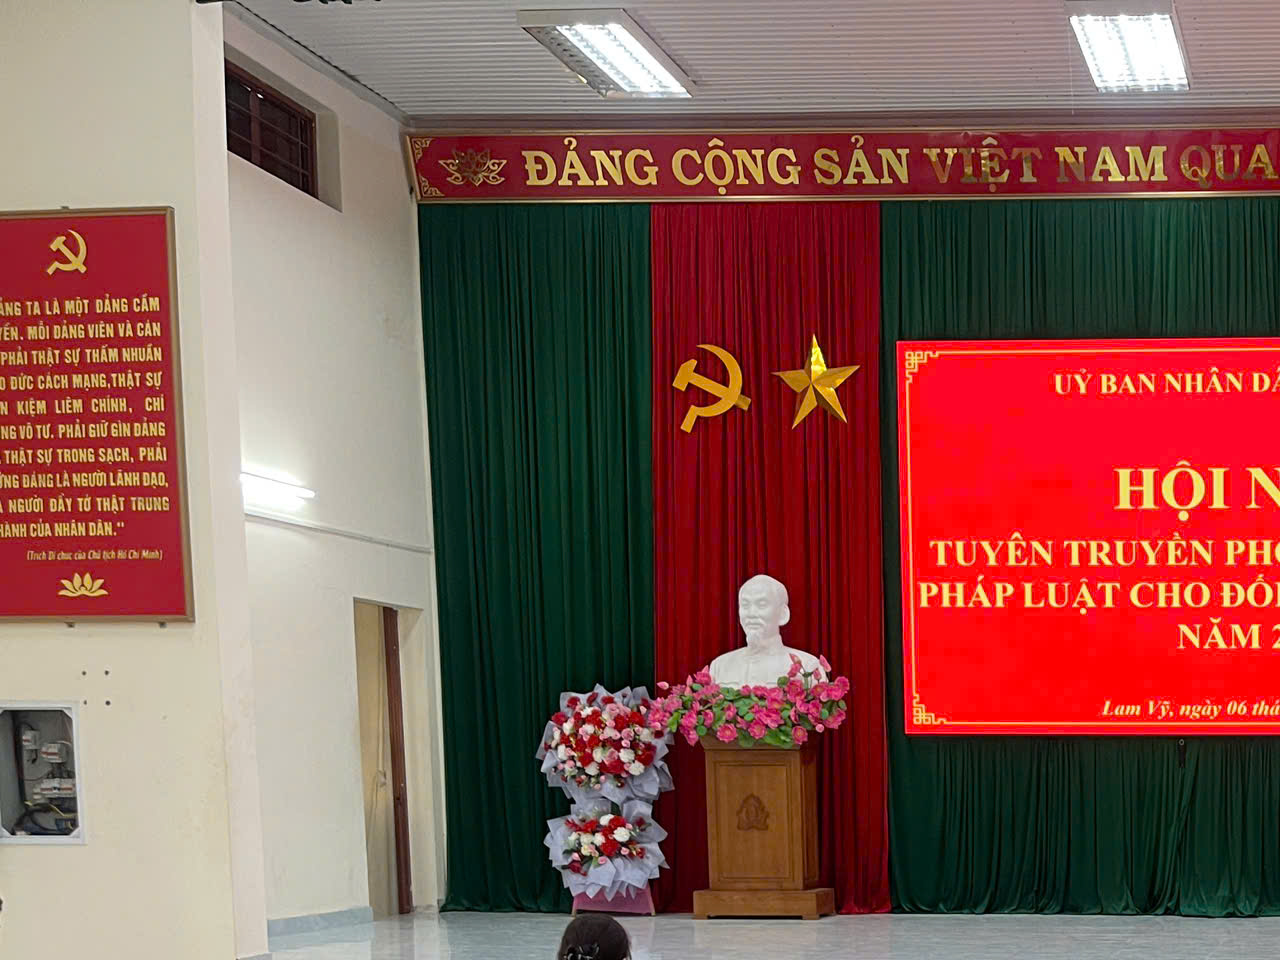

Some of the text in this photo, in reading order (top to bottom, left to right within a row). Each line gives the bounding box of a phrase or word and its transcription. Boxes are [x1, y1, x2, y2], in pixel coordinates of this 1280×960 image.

[522, 137, 658, 185] ĐẢNG
[672, 138, 801, 194] CỘNG
[814, 135, 909, 184] SẢN
[923, 137, 1042, 192] VIỆT
[1055, 146, 1168, 182] NAM
[26, 301, 40, 315] TA
[45, 298, 60, 315] LÀ
[65, 297, 89, 317] MỘT
[96, 294, 128, 313] ĐẢNG
[54, 320, 85, 339] ĐẢNG
[88, 321, 114, 338] VIÊN
[118, 320, 133, 337] VÀ
[0, 346, 27, 365] PHẢI
[32, 347, 60, 367] THẬT
[64, 348, 80, 366] SỰ
[10, 373, 33, 390] ĐỨC
[38, 372, 68, 389] CÁCH
[146, 371, 162, 389] SỰ
[1056, 369, 1092, 394] UỶ
[1101, 374, 1155, 394] BAN
[1165, 367, 1242, 392] NHÂN
[17, 398, 46, 417] KIỆM
[55, 397, 83, 413] LIÊM
[92, 395, 132, 413] CHÍNH,
[145, 394, 164, 411] CHÍ
[19, 417, 165, 439] VÔ TƯ. PHẢI GIỮ GÌN ĐẢNG
[4, 442, 166, 466] THẬT SỰ TRONG SẠCH, PHẢI
[23, 470, 168, 488] ĐÁNG LÀ NGƯỜI LÃNH ĐẠO,
[1115, 460, 1229, 521] HỘI
[9, 495, 43, 513] NGƯỜI
[50, 493, 72, 512] ĐẦY
[96, 495, 124, 514] THẬT
[131, 497, 169, 511] TRUNG
[30, 519, 52, 537] CỦA
[55, 520, 86, 536] NHÂN
[930, 532, 1052, 566] TUYÊN
[1064, 532, 1213, 566] TRUYỀN
[919, 575, 1014, 607] PHÁP
[1024, 578, 1120, 615] LUẬT
[1130, 582, 1210, 607] CHO
[1178, 618, 1260, 649] NĂM
[1102, 701, 1141, 715] Lam
[1149, 700, 1173, 720] Vỹ,
[1180, 700, 1222, 719] ngày
[1227, 701, 1247, 715] 06
